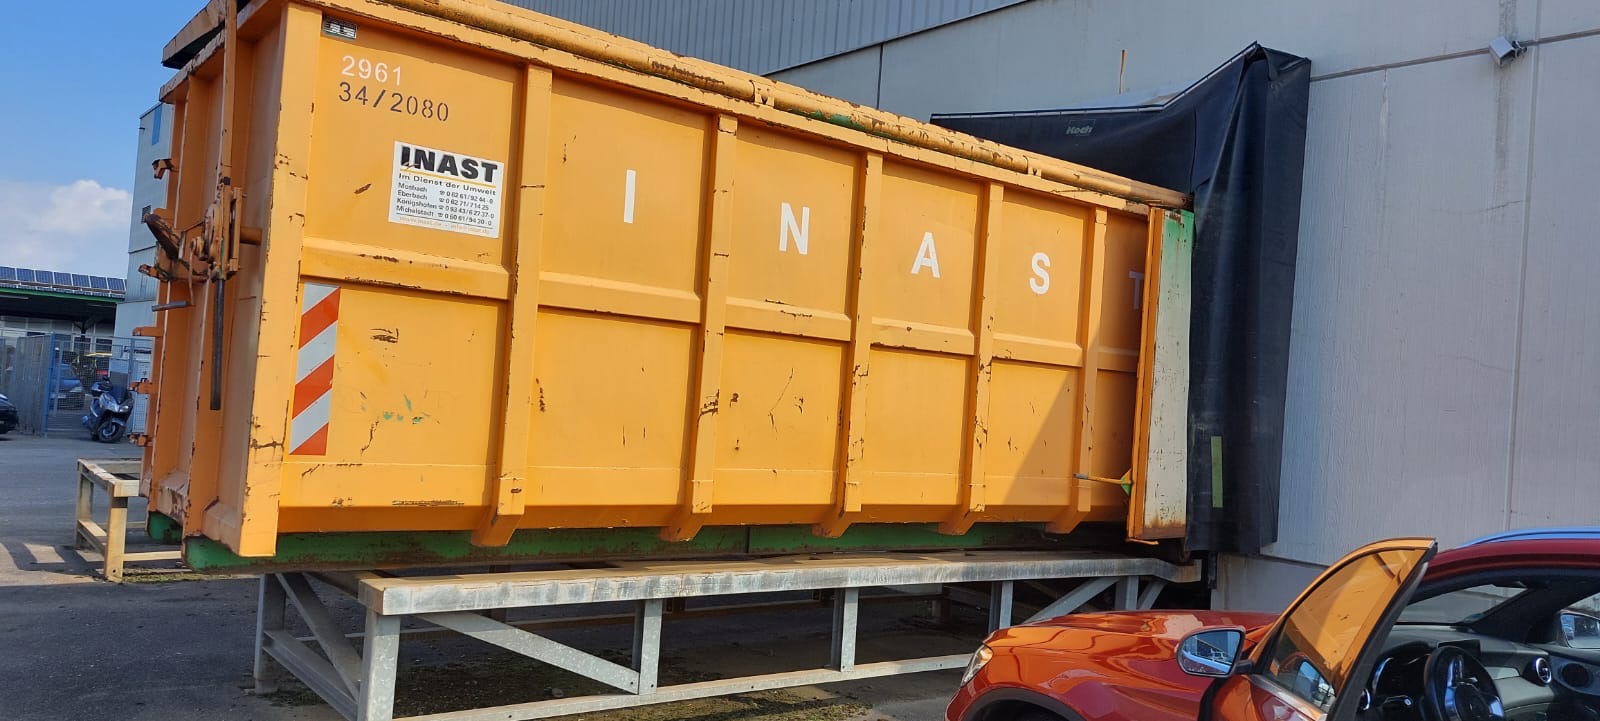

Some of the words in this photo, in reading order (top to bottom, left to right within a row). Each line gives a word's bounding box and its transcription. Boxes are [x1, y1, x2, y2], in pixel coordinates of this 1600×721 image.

[341, 55, 401, 86] 2961
[338, 82, 449, 122] 34/2080
[400, 146, 498, 183] INAST
[414, 176, 442, 186] Dienst
[464, 185, 496, 195] Umwelt
